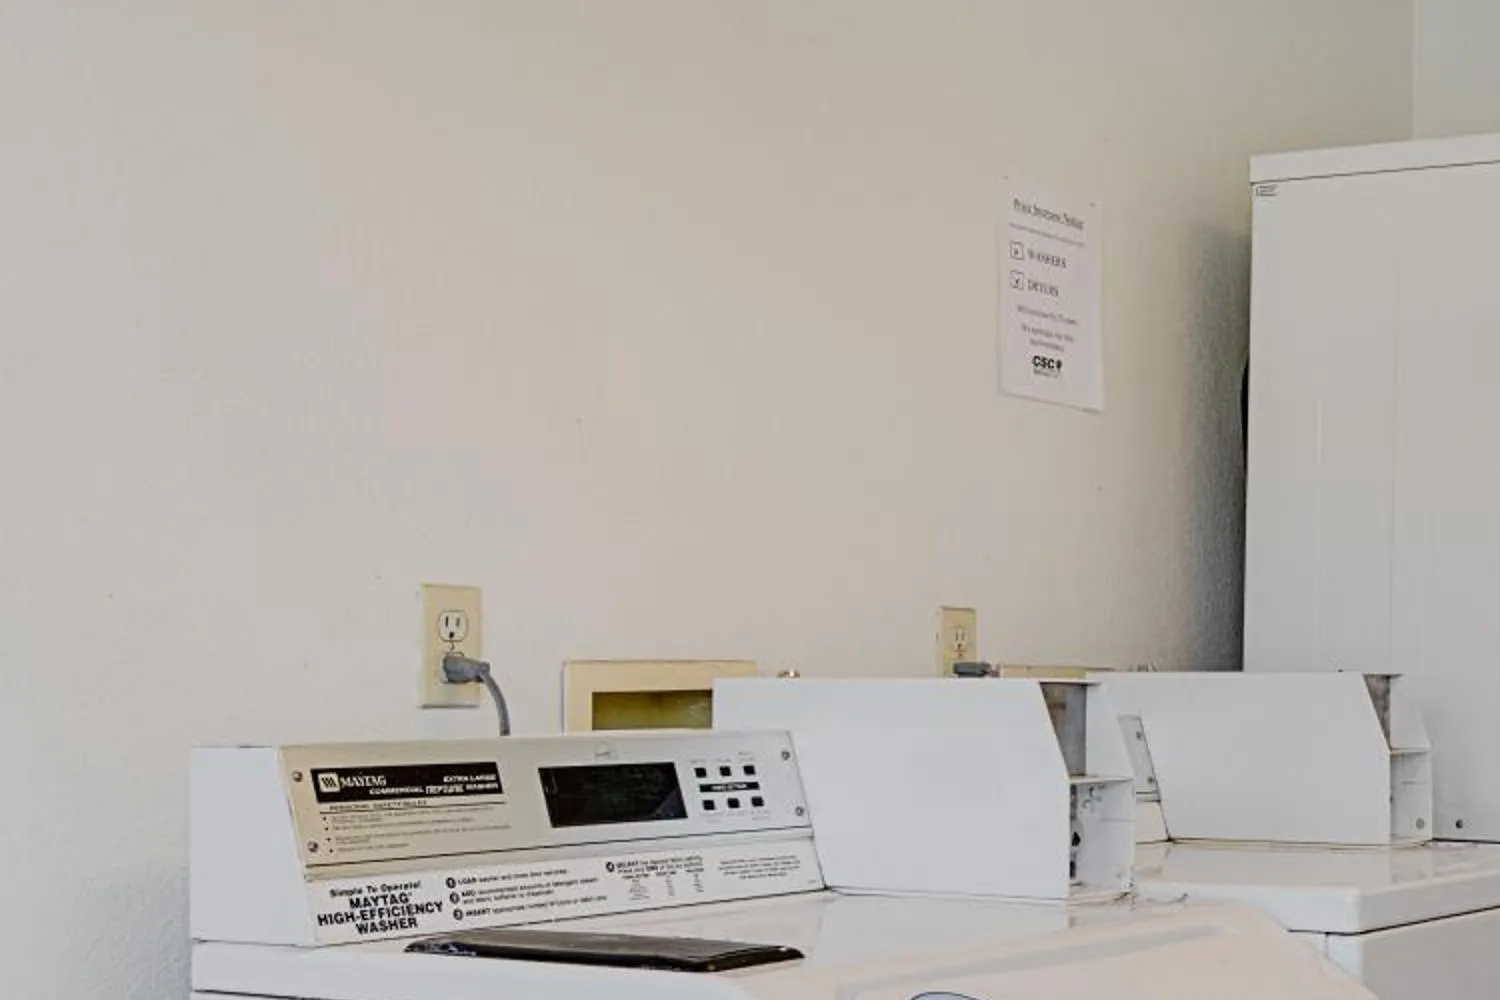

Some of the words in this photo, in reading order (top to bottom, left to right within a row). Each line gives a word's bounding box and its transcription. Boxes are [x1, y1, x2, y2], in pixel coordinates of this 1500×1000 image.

[1032, 355, 1055, 369] CSC
[339, 775, 387, 788] MAYTAG
[330, 888, 363, 897] Simple
[366, 885, 378, 894] To
[349, 892, 410, 909] MAYTAG
[317, 901, 443, 926] HIGH-EFFICIENCY
[355, 917, 419, 934] WASHER
